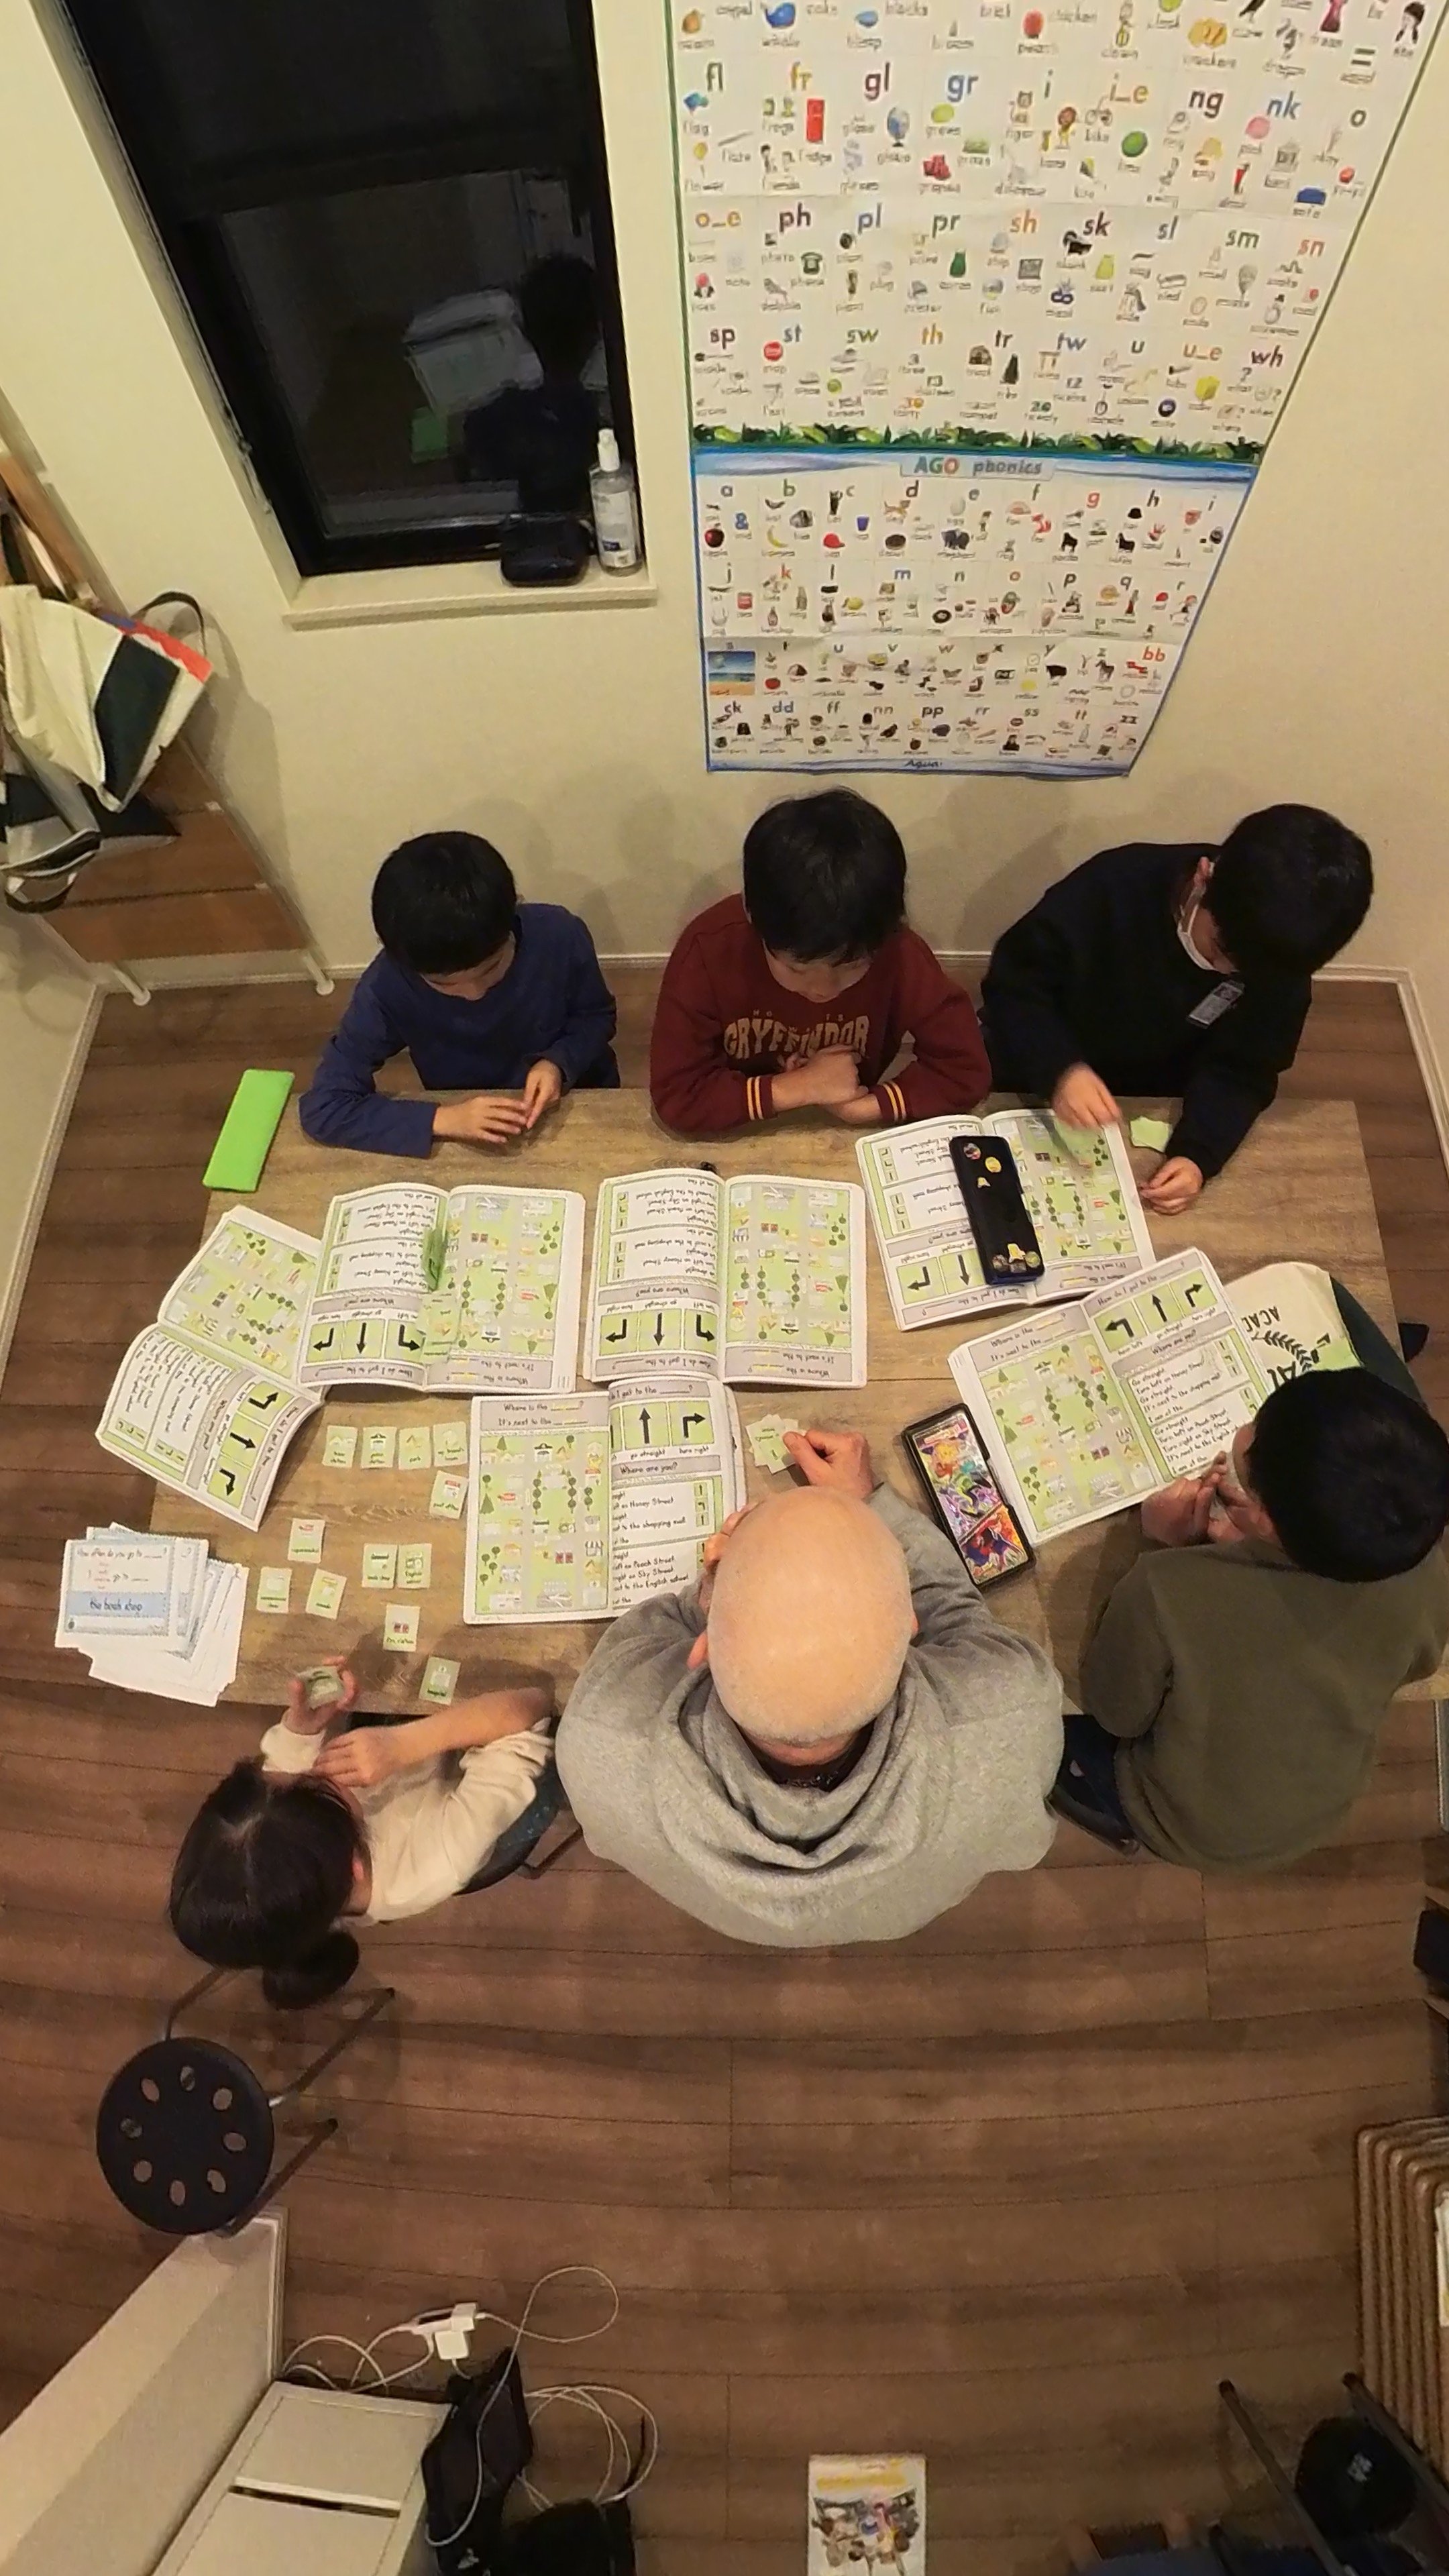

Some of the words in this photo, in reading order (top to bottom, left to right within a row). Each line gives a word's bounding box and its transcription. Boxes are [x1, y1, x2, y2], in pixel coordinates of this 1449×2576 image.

[706, 62, 722, 91] fl
[792, 62, 811, 91] fr
[865, 62, 890, 101] gl
[947, 74, 978, 103] gr
[1044, 69, 1053, 98] i
[1189, 89, 1224, 117] ng
[1267, 91, 1300, 120] nk
[1350, 109, 1366, 127] o
[779, 203, 812, 233] ph
[858, 203, 882, 235] pl
[932, 213, 961, 238] pr
[1010, 210, 1038, 233] sh
[1083, 211, 1112, 237] sk
[1157, 216, 1179, 241] sl
[1225, 231, 1259, 248] sm
[1298, 237, 1325, 256] sn
[710, 328, 735, 350] sp
[784, 324, 802, 343] st
[846, 327, 880, 343] sw
[921, 325, 943, 344] th
[994, 329, 1014, 348] tr
[1057, 333, 1087, 352] tw
[1131, 339, 1144, 354] u
[1251, 345, 1283, 368] wh
[914, 455, 959, 475] AGO
[973, 460, 1042, 477] phonics
[720, 485, 733, 497] a
[783, 478, 796, 496] b
[846, 486, 856, 497] c
[906, 480, 920, 498] d
[968, 488, 979, 500] e
[1031, 483, 1040, 500] f
[1087, 492, 1100, 508] g
[1146, 489, 1160, 507] h
[1208, 495, 1218, 511] i
[725, 562, 733, 583] j
[782, 564, 791, 579] k
[894, 569, 911, 580] m
[955, 570, 965, 581] n
[1010, 571, 1020, 582] o
[1064, 574, 1077, 588] p
[1120, 576, 1132, 591] q
[1177, 581, 1185, 590] r
[772, 700, 794, 714] dd
[826, 700, 841, 714] ff
[873, 706, 894, 714] nn
[921, 706, 944, 718] pp
[975, 706, 990, 715] rr
[1024, 708, 1039, 716] ss
[1075, 710, 1087, 720] tt
[1120, 715, 1138, 724] zz
[724, 1014, 870, 1059] GRYFFINDOR
[503, 1403, 527, 1411] Where
